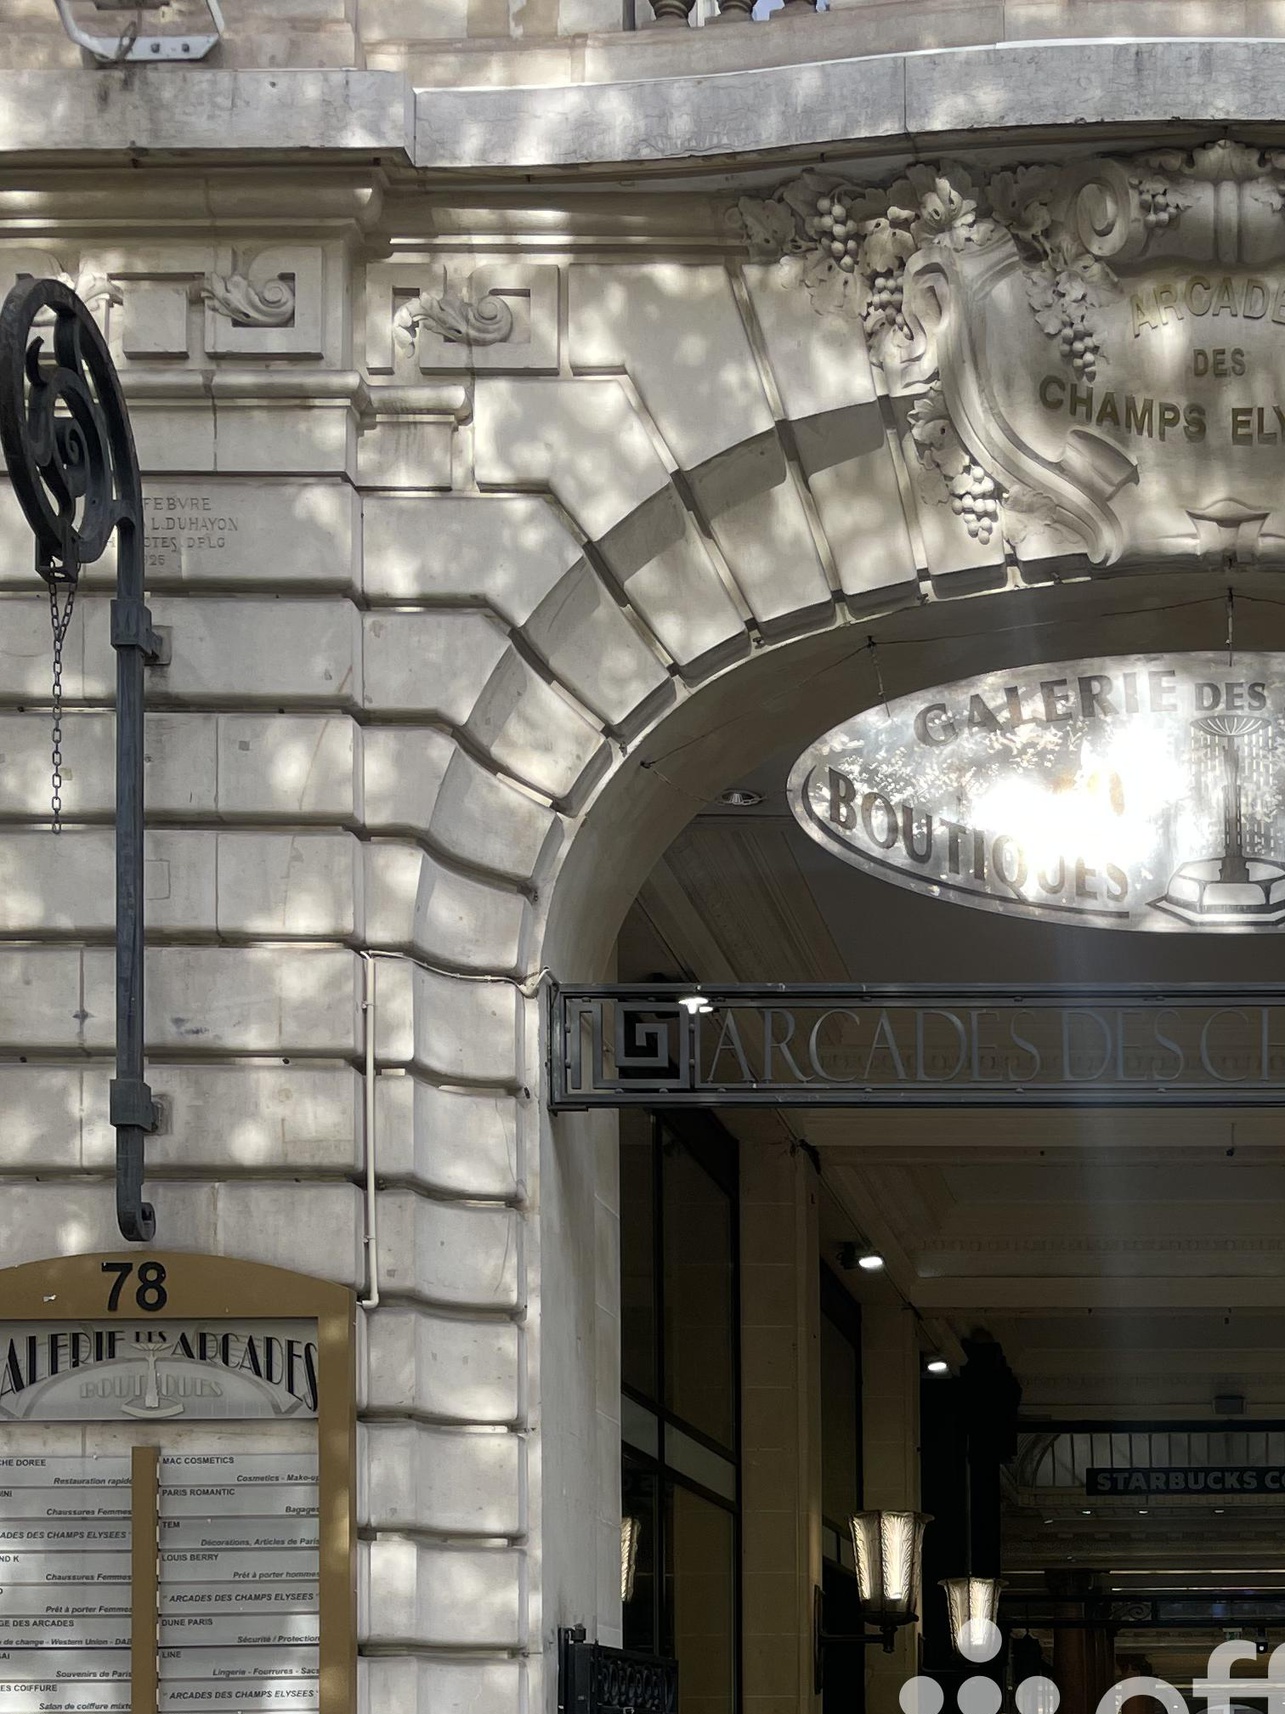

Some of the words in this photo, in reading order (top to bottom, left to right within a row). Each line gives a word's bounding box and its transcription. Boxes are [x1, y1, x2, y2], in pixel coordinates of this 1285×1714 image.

[1193, 347, 1246, 378] DES
[1038, 374, 1207, 442] CHAMPS
[912, 668, 1178, 748] GALERIE
[1193, 681, 1268, 712] DES
[707, 1007, 1041, 1083] ARCADES
[1060, 1007, 1186, 1083] DES
[101, 1261, 168, 1311] 78
[135, 1330, 167, 1343] DES
[80, 1373, 224, 1399] BOUTQUES
[162, 1456, 182, 1465] MAC
[184, 1456, 235, 1465] COSMETICS
[236, 1474, 280, 1482] Cosmetics
[1096, 1467, 1258, 1490] STARBUCKS
[161, 1488, 187, 1496] PARIS
[189, 1488, 236, 1496] ROMANTIC
[46, 1508, 95, 1516] Chaussures
[162, 1521, 180, 1529] TEM
[26, 1531, 45, 1539] DES
[47, 1531, 85, 1539] CHAMPS
[86, 1531, 127, 1539] ELYSEES
[161, 1553, 187, 1562] LOUIS
[189, 1553, 219, 1562] BERRY
[45, 1573, 95, 1581] Chaussures
[169, 1594, 213, 1603] ARCADES
[214, 1594, 232, 1602] DES
[234, 1593, 272, 1601] CHAMPS
[274, 1592, 314, 1601] ELYSEES
[12, 1619, 30, 1627] DES
[32, 1619, 75, 1627] ARCADES
[161, 1618, 185, 1627] DUNE
[187, 1618, 213, 1626] PARIS
[161, 1650, 182, 1659] LINE
[14, 1684, 58, 1692] COIFFURE
[169, 1692, 213, 1700] ARCADES
[214, 1691, 232, 1699] DES
[234, 1691, 272, 1699] CHAMPS
[274, 1690, 314, 1698] ELYSEES
